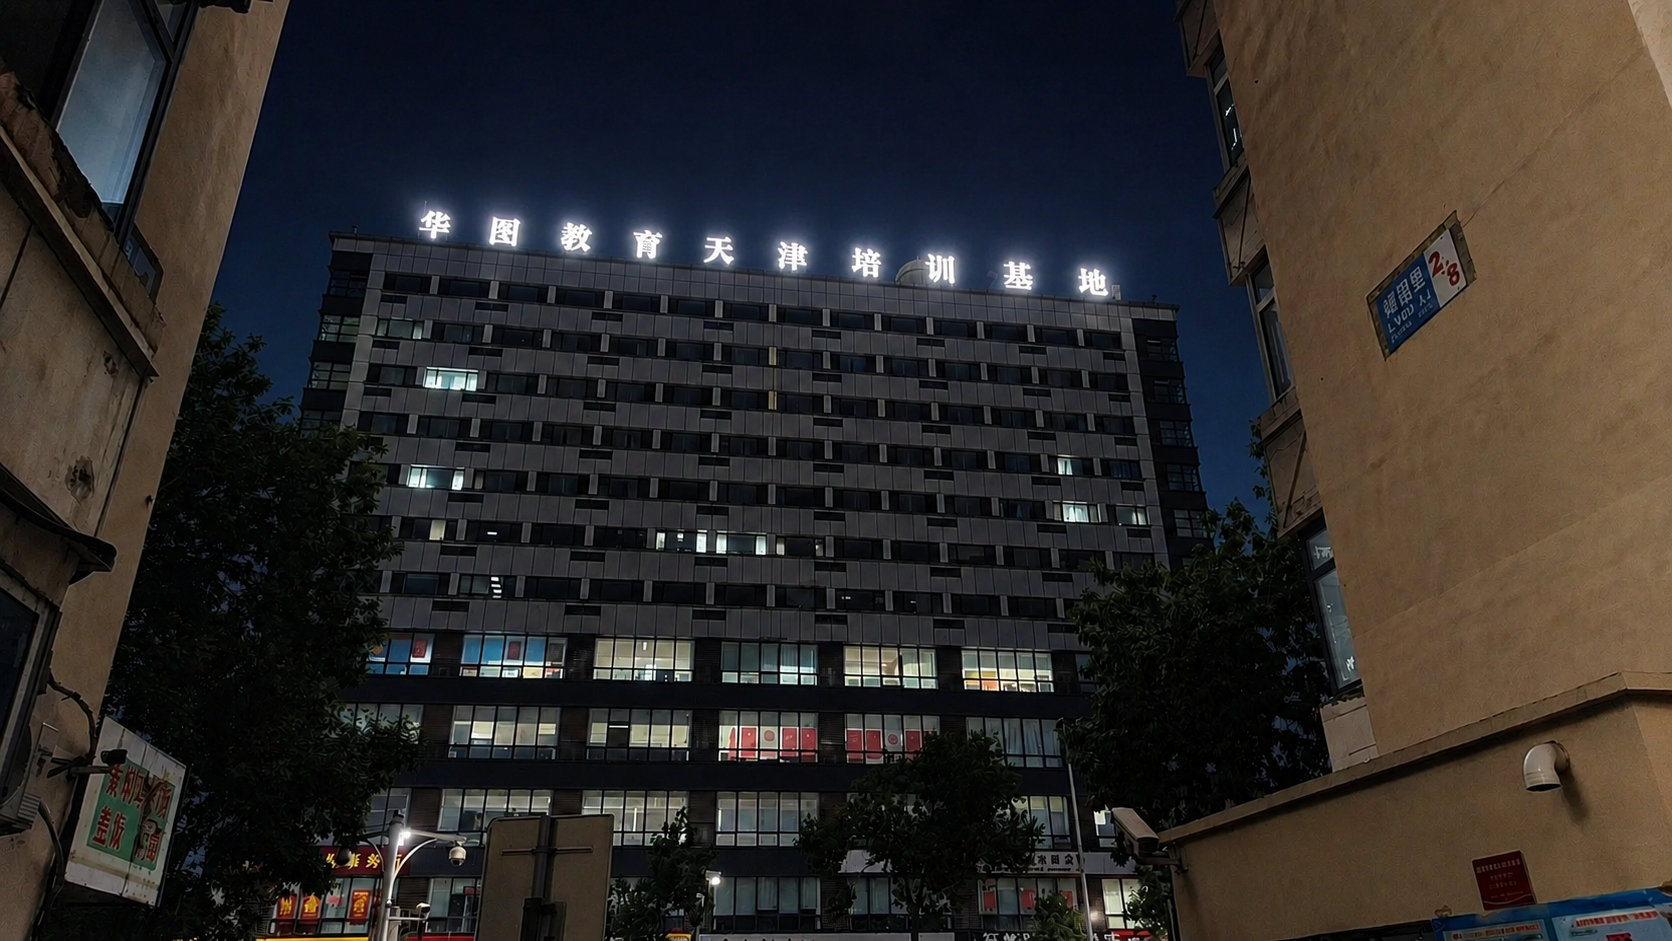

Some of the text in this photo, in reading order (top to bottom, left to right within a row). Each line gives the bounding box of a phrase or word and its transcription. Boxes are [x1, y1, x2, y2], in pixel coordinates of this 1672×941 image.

[419, 209, 1109, 298] 华图教育天津培训基地
